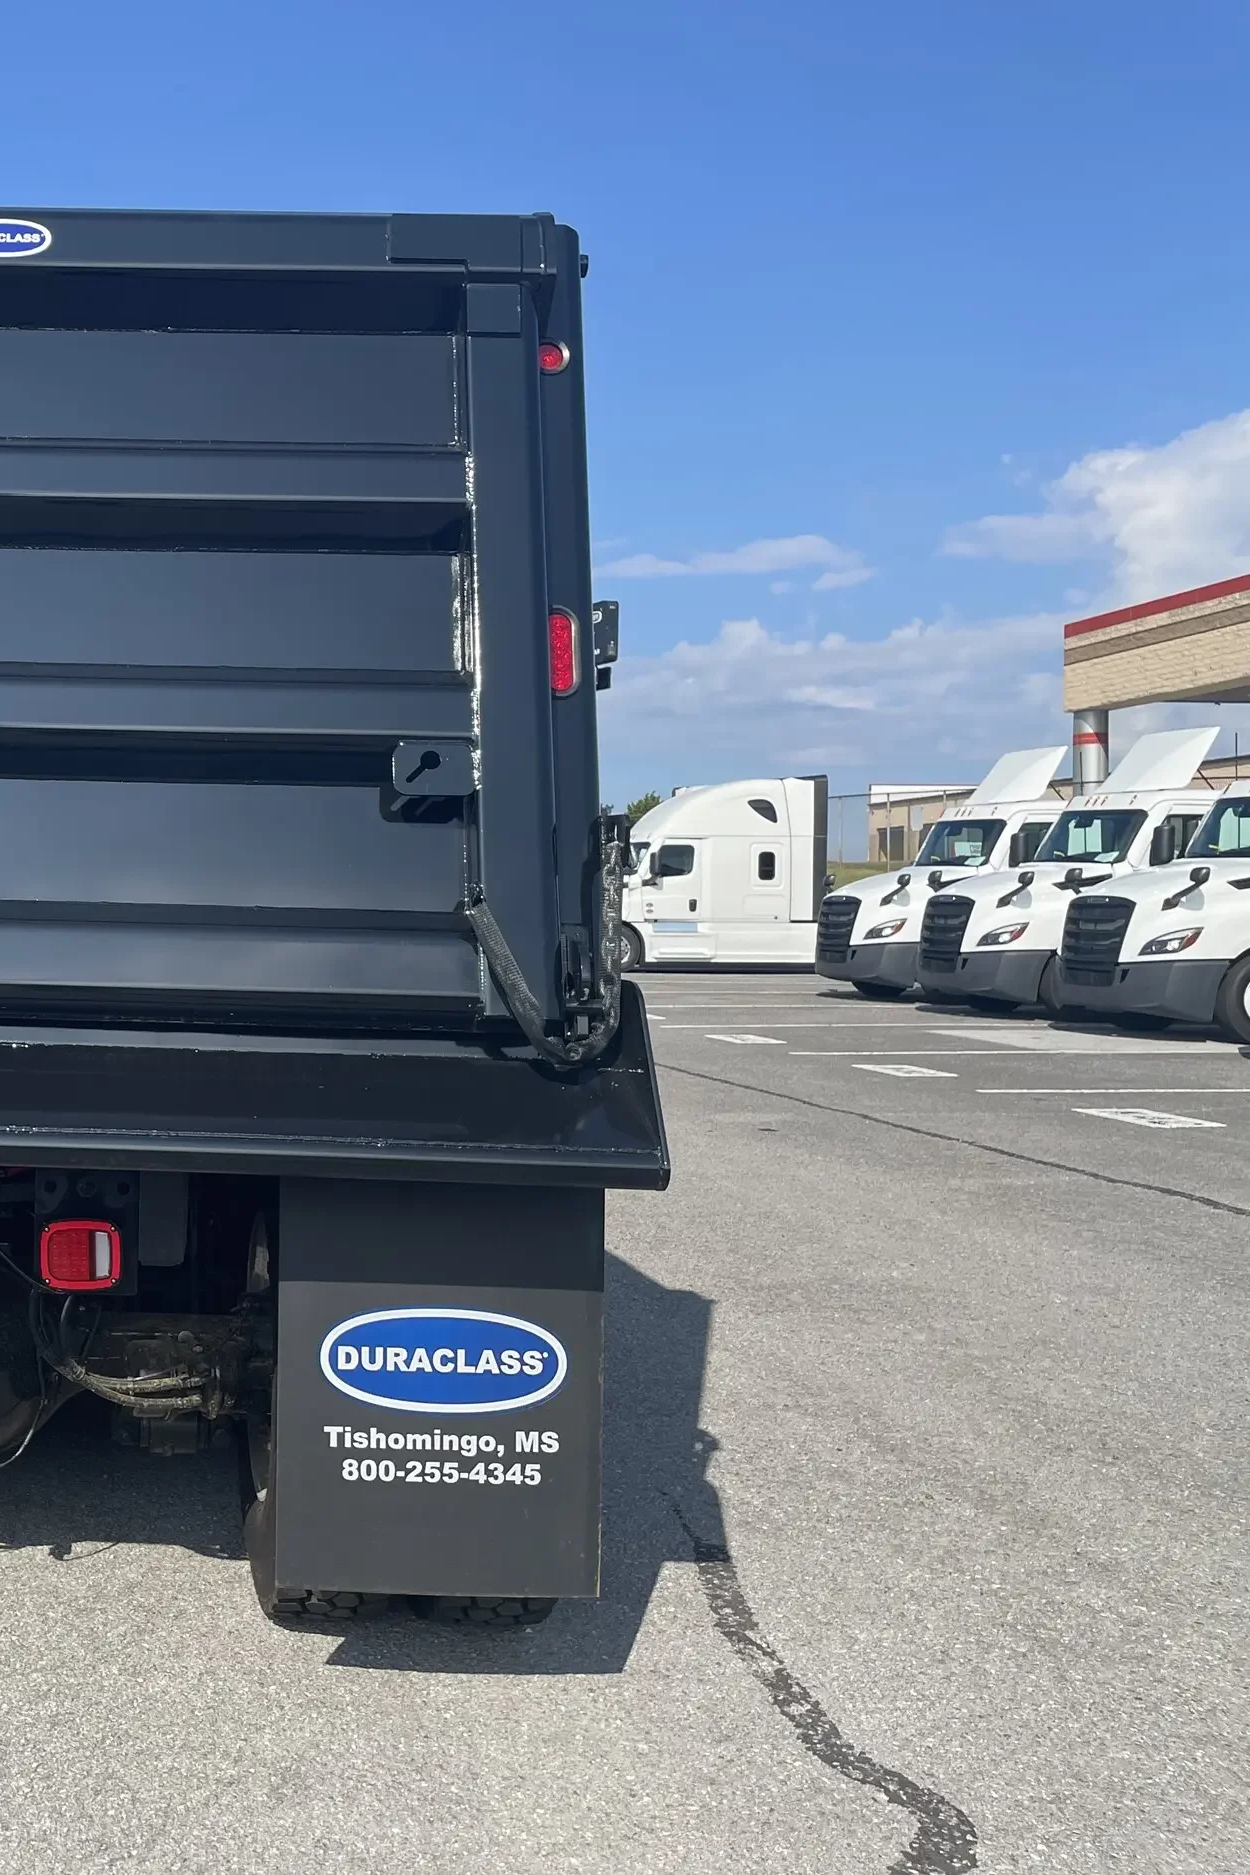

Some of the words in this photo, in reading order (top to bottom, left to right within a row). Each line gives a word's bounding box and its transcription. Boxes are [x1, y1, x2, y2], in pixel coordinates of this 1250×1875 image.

[337, 1346, 544, 1376] DURACLASS
[323, 1425, 505, 1458] Tishomingo,
[515, 1430, 560, 1453] MS
[341, 1458, 542, 1486] 800-255-4345
